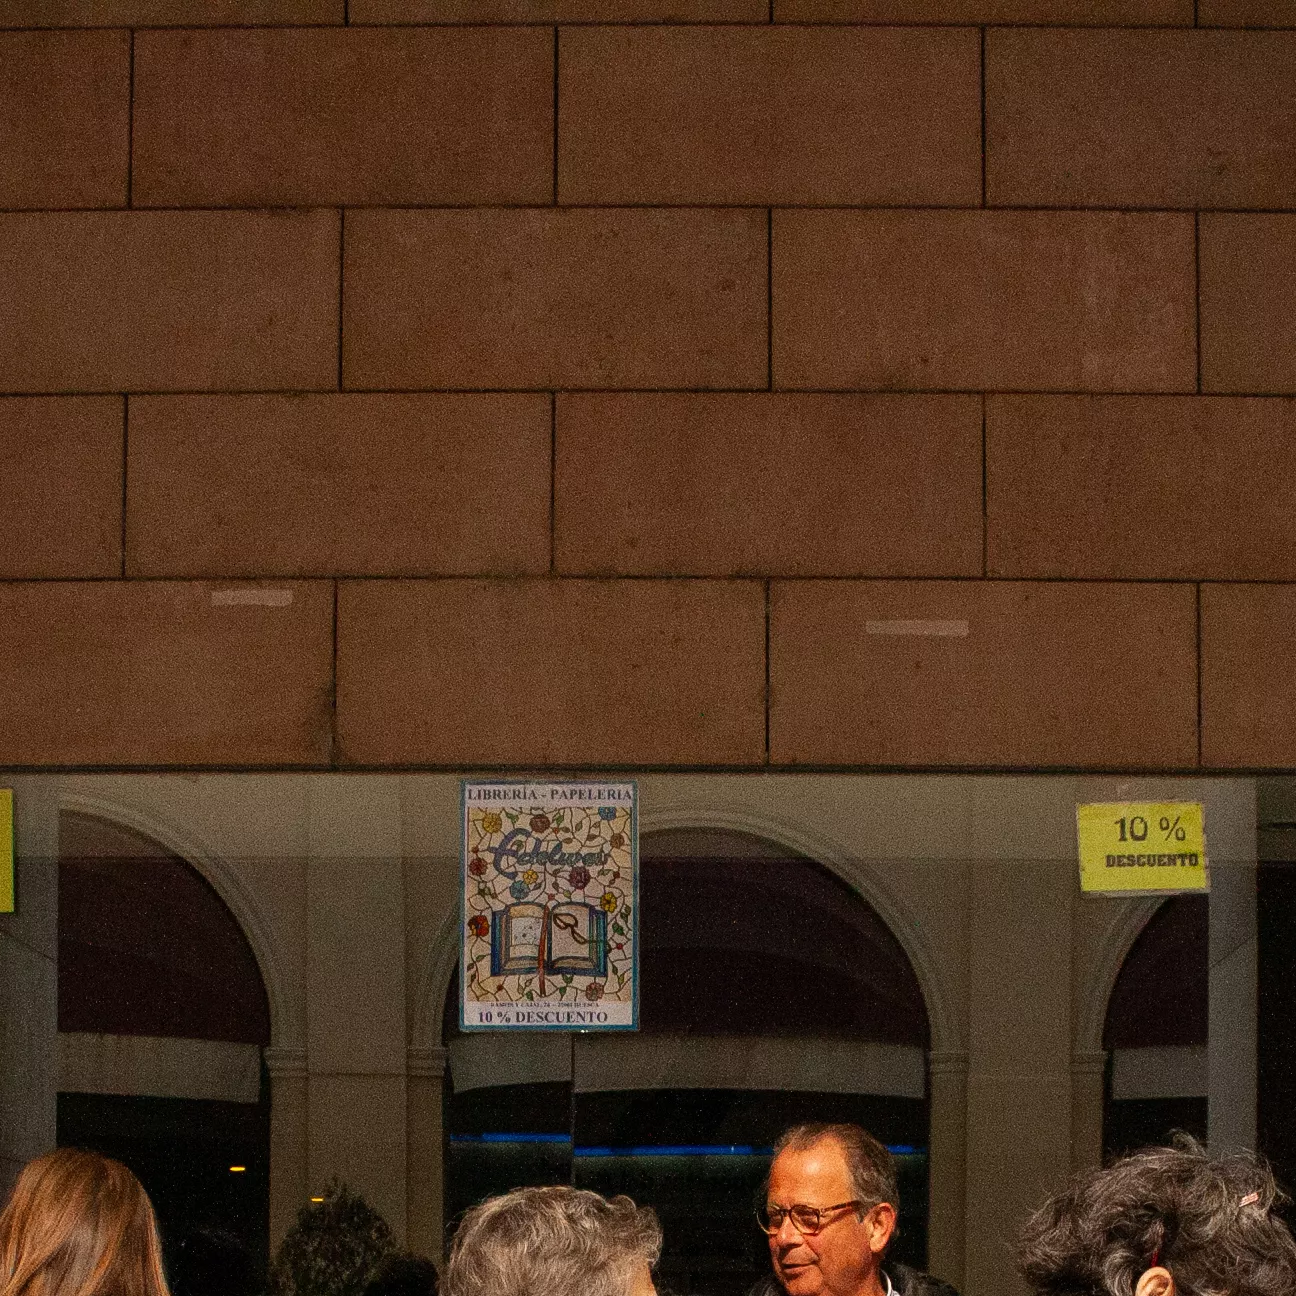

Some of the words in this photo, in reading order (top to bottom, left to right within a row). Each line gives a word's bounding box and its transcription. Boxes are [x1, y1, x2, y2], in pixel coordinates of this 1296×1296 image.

[1115, 817, 1148, 841] 10
[1159, 816, 1186, 841] %
[1106, 853, 1199, 868] DESCUENTO
[479, 1011, 493, 1023] 10
[497, 1011, 511, 1023] %
[516, 1010, 608, 1023] DESCUENTO
